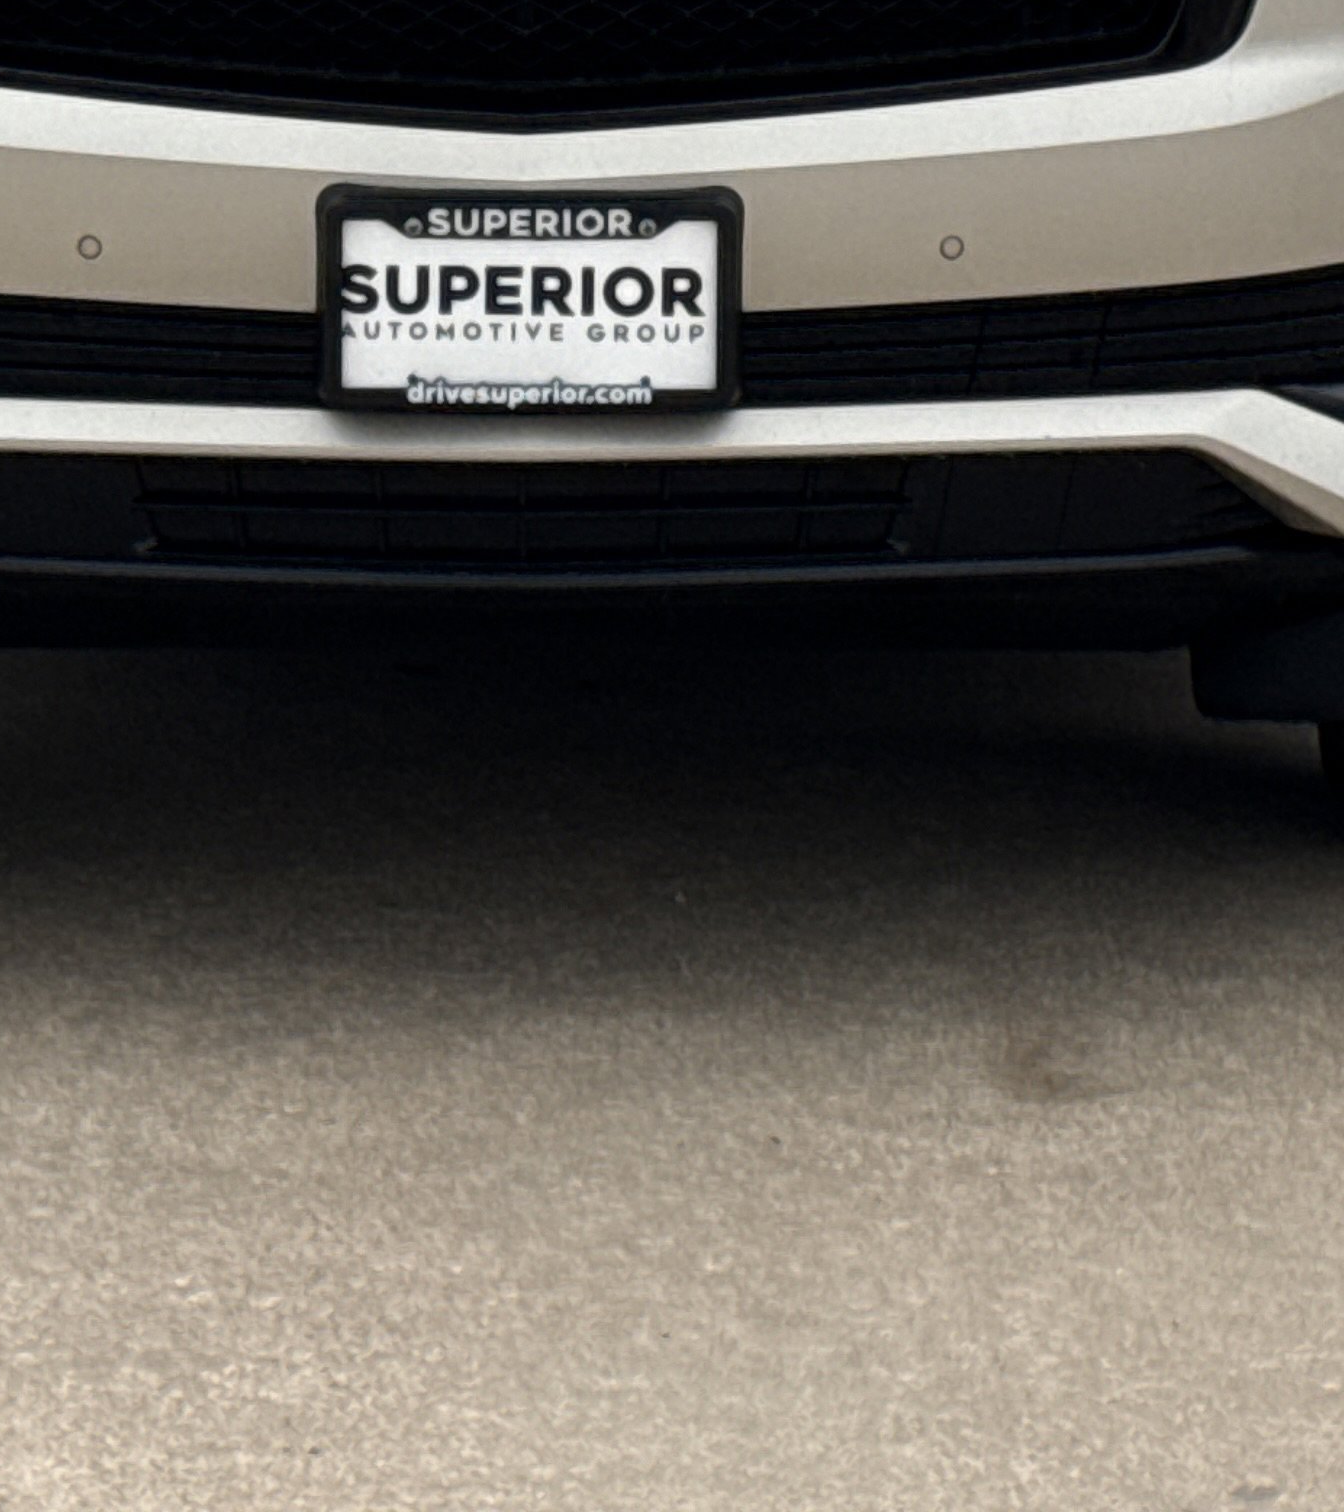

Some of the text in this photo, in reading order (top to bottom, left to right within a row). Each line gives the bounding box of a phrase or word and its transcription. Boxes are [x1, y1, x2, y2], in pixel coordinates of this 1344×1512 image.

[427, 207, 633, 237] SUPERIOR
[342, 263, 706, 318] SUPERIOR
[342, 320, 705, 344] AUTOMOTIVE GROUP
[407, 379, 653, 410] drivesuperior.com
